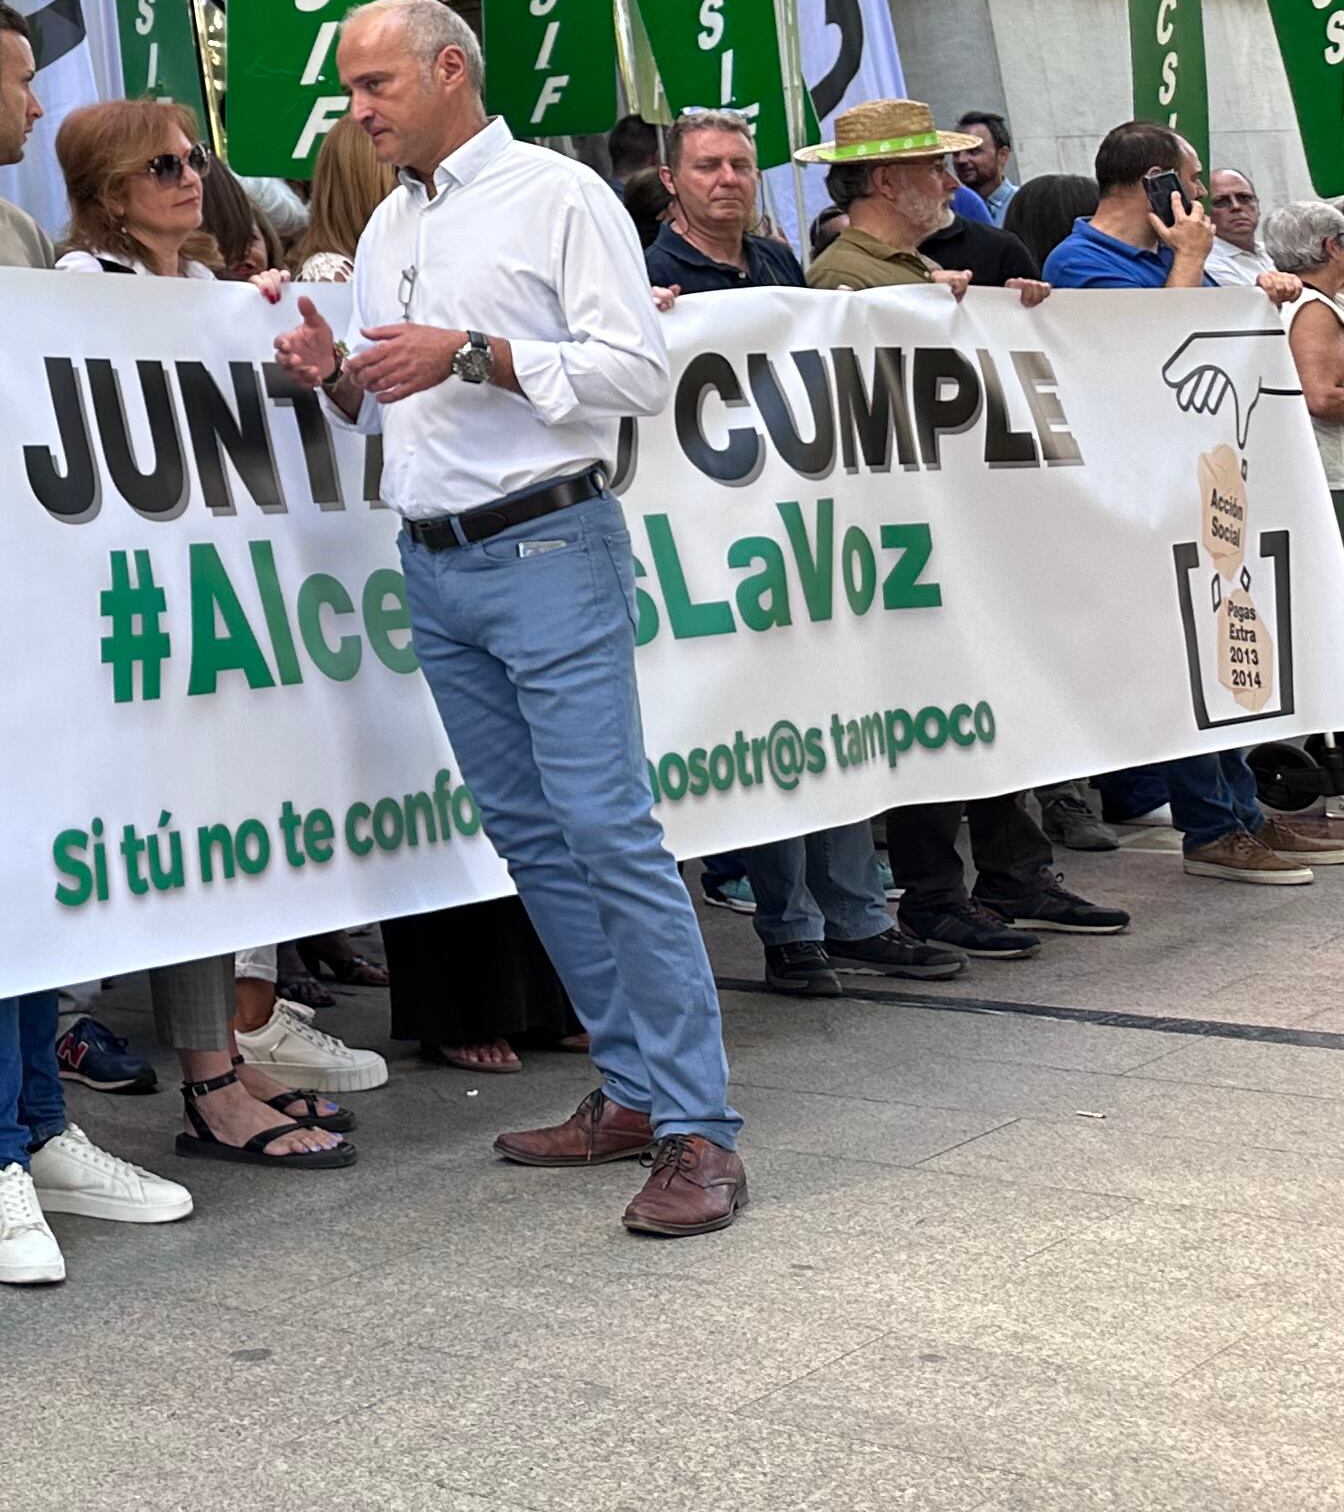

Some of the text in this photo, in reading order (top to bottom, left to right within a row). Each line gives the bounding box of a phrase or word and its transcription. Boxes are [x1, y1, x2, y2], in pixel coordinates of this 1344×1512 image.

[23, 356, 384, 526] JUNT
[674, 346, 1085, 488] CUMPLE
[1210, 487, 1244, 522] Acción
[1211, 515, 1241, 548] Social
[1227, 600, 1257, 623] Pagas
[1229, 623, 1257, 643] Extra
[1230, 646, 1259, 666] 2013
[1231, 669, 1262, 688] 2014
[52, 818, 110, 907] Si
[120, 809, 184, 899] tú
[199, 819, 270, 885] no
[280, 800, 335, 866] te
[344, 768, 481, 857] confo
[829, 698, 996, 769] tampoco
